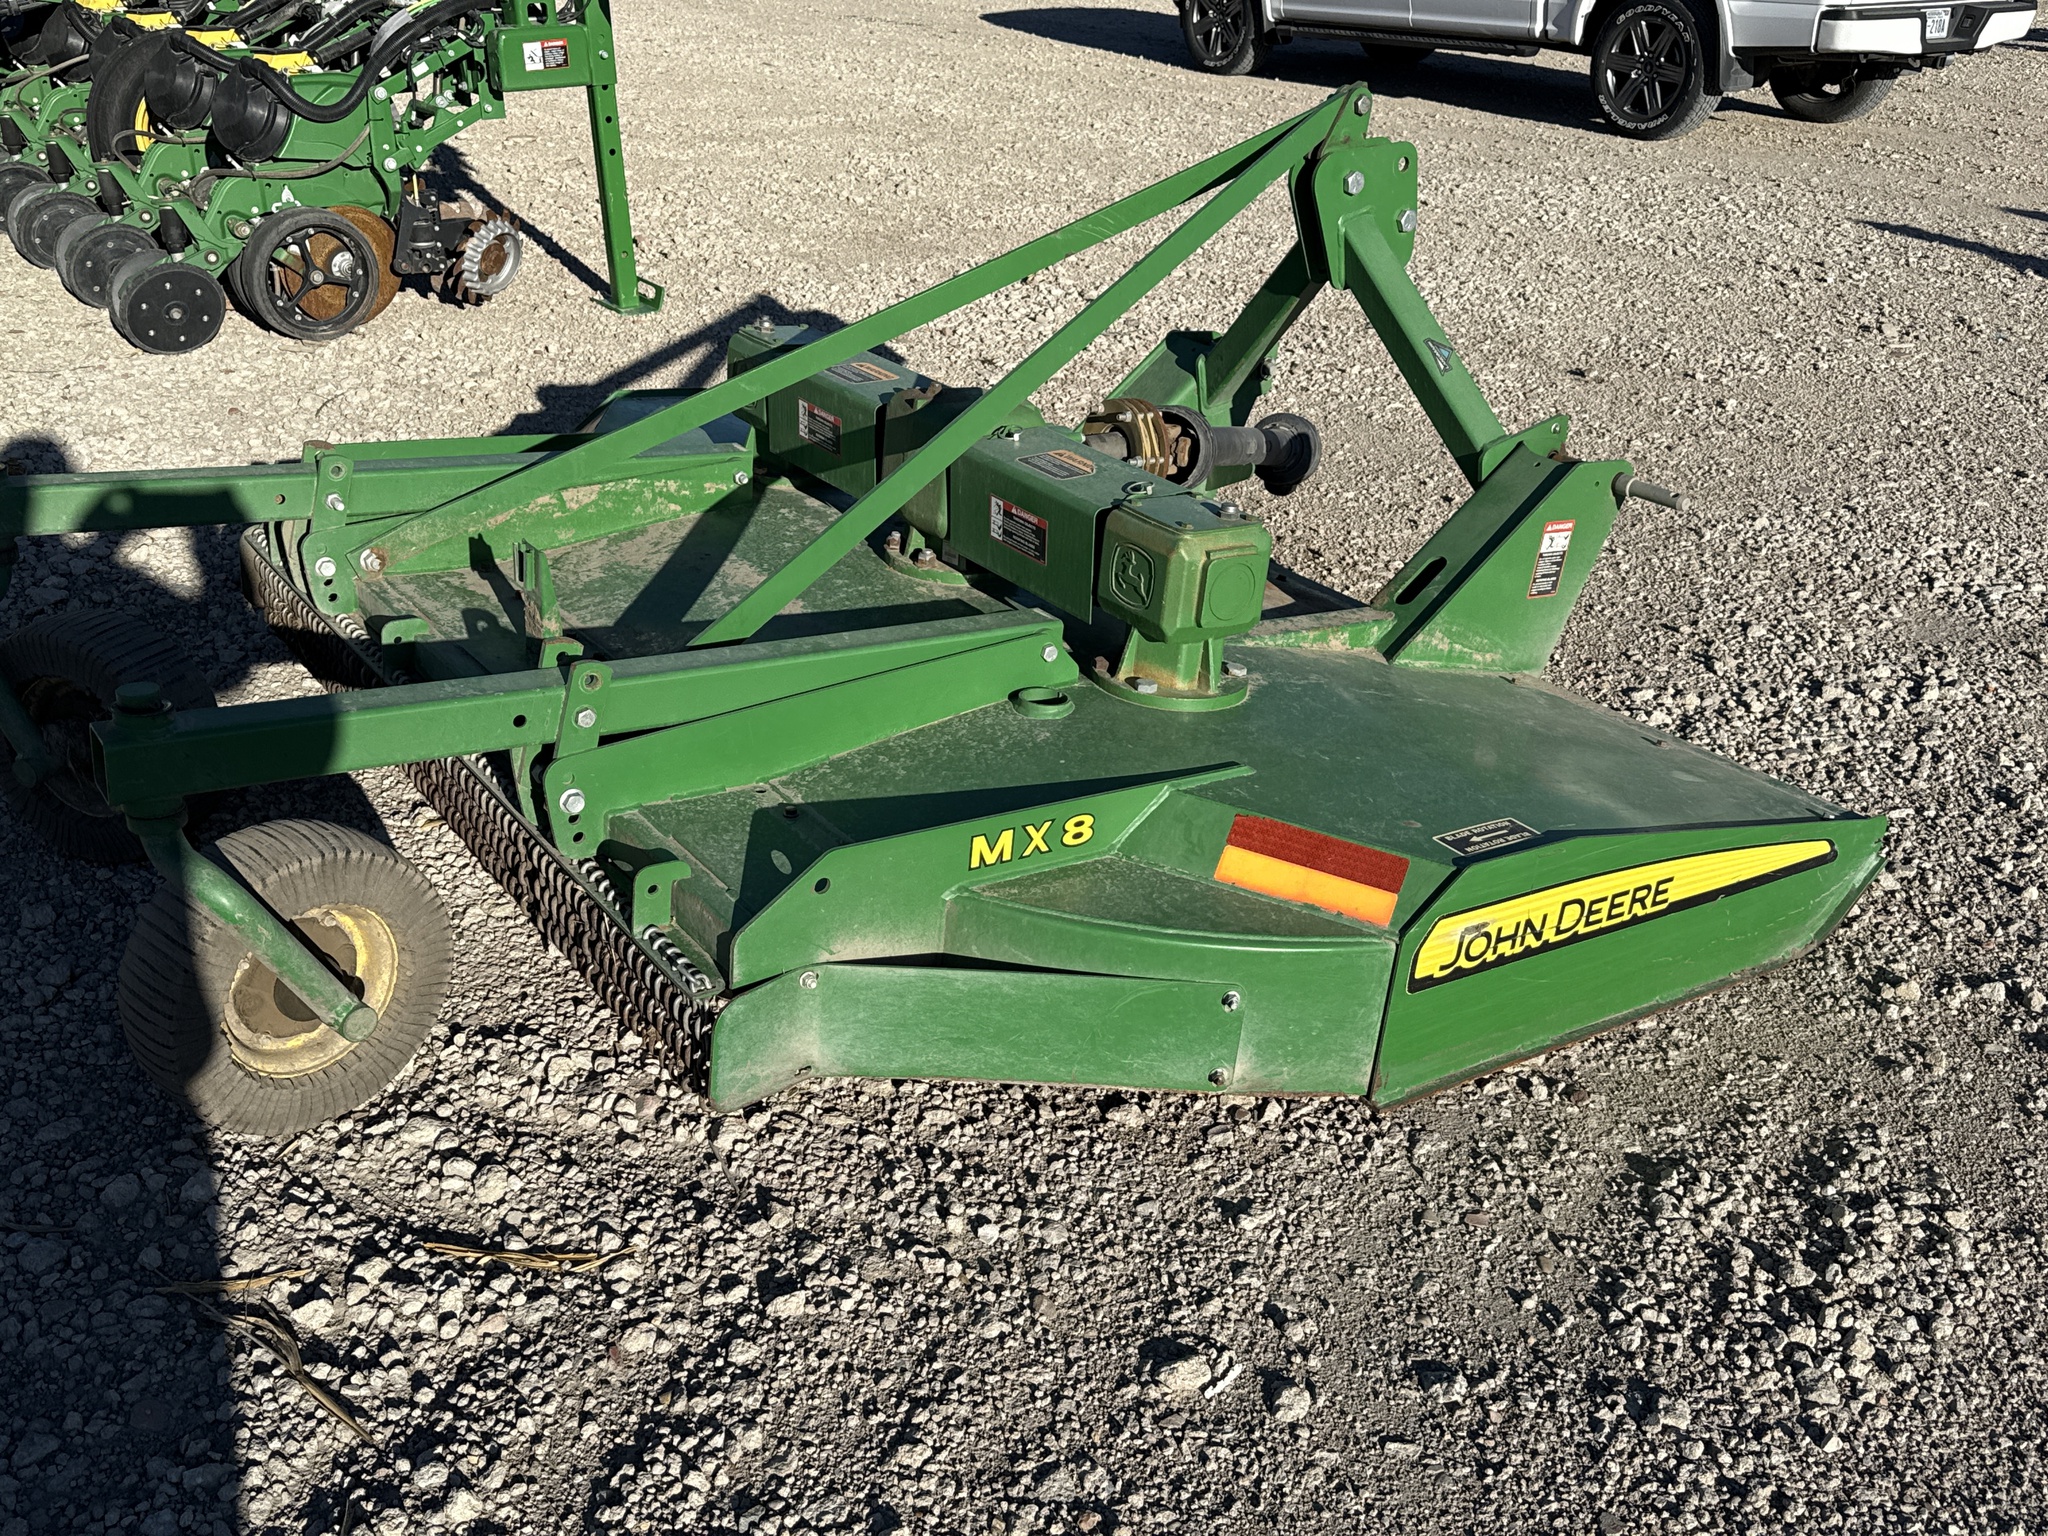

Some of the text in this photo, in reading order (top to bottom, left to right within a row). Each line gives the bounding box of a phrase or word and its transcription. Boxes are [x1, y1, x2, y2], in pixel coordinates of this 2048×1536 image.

[1616, 4, 1690, 42] GOODYEAR
[1598, 94, 1669, 129] WRANGLER
[1017, 510, 1039, 526] DANGER
[1444, 821, 1511, 842] BLADE ROTATION
[1554, 877, 1674, 936] DEERE
